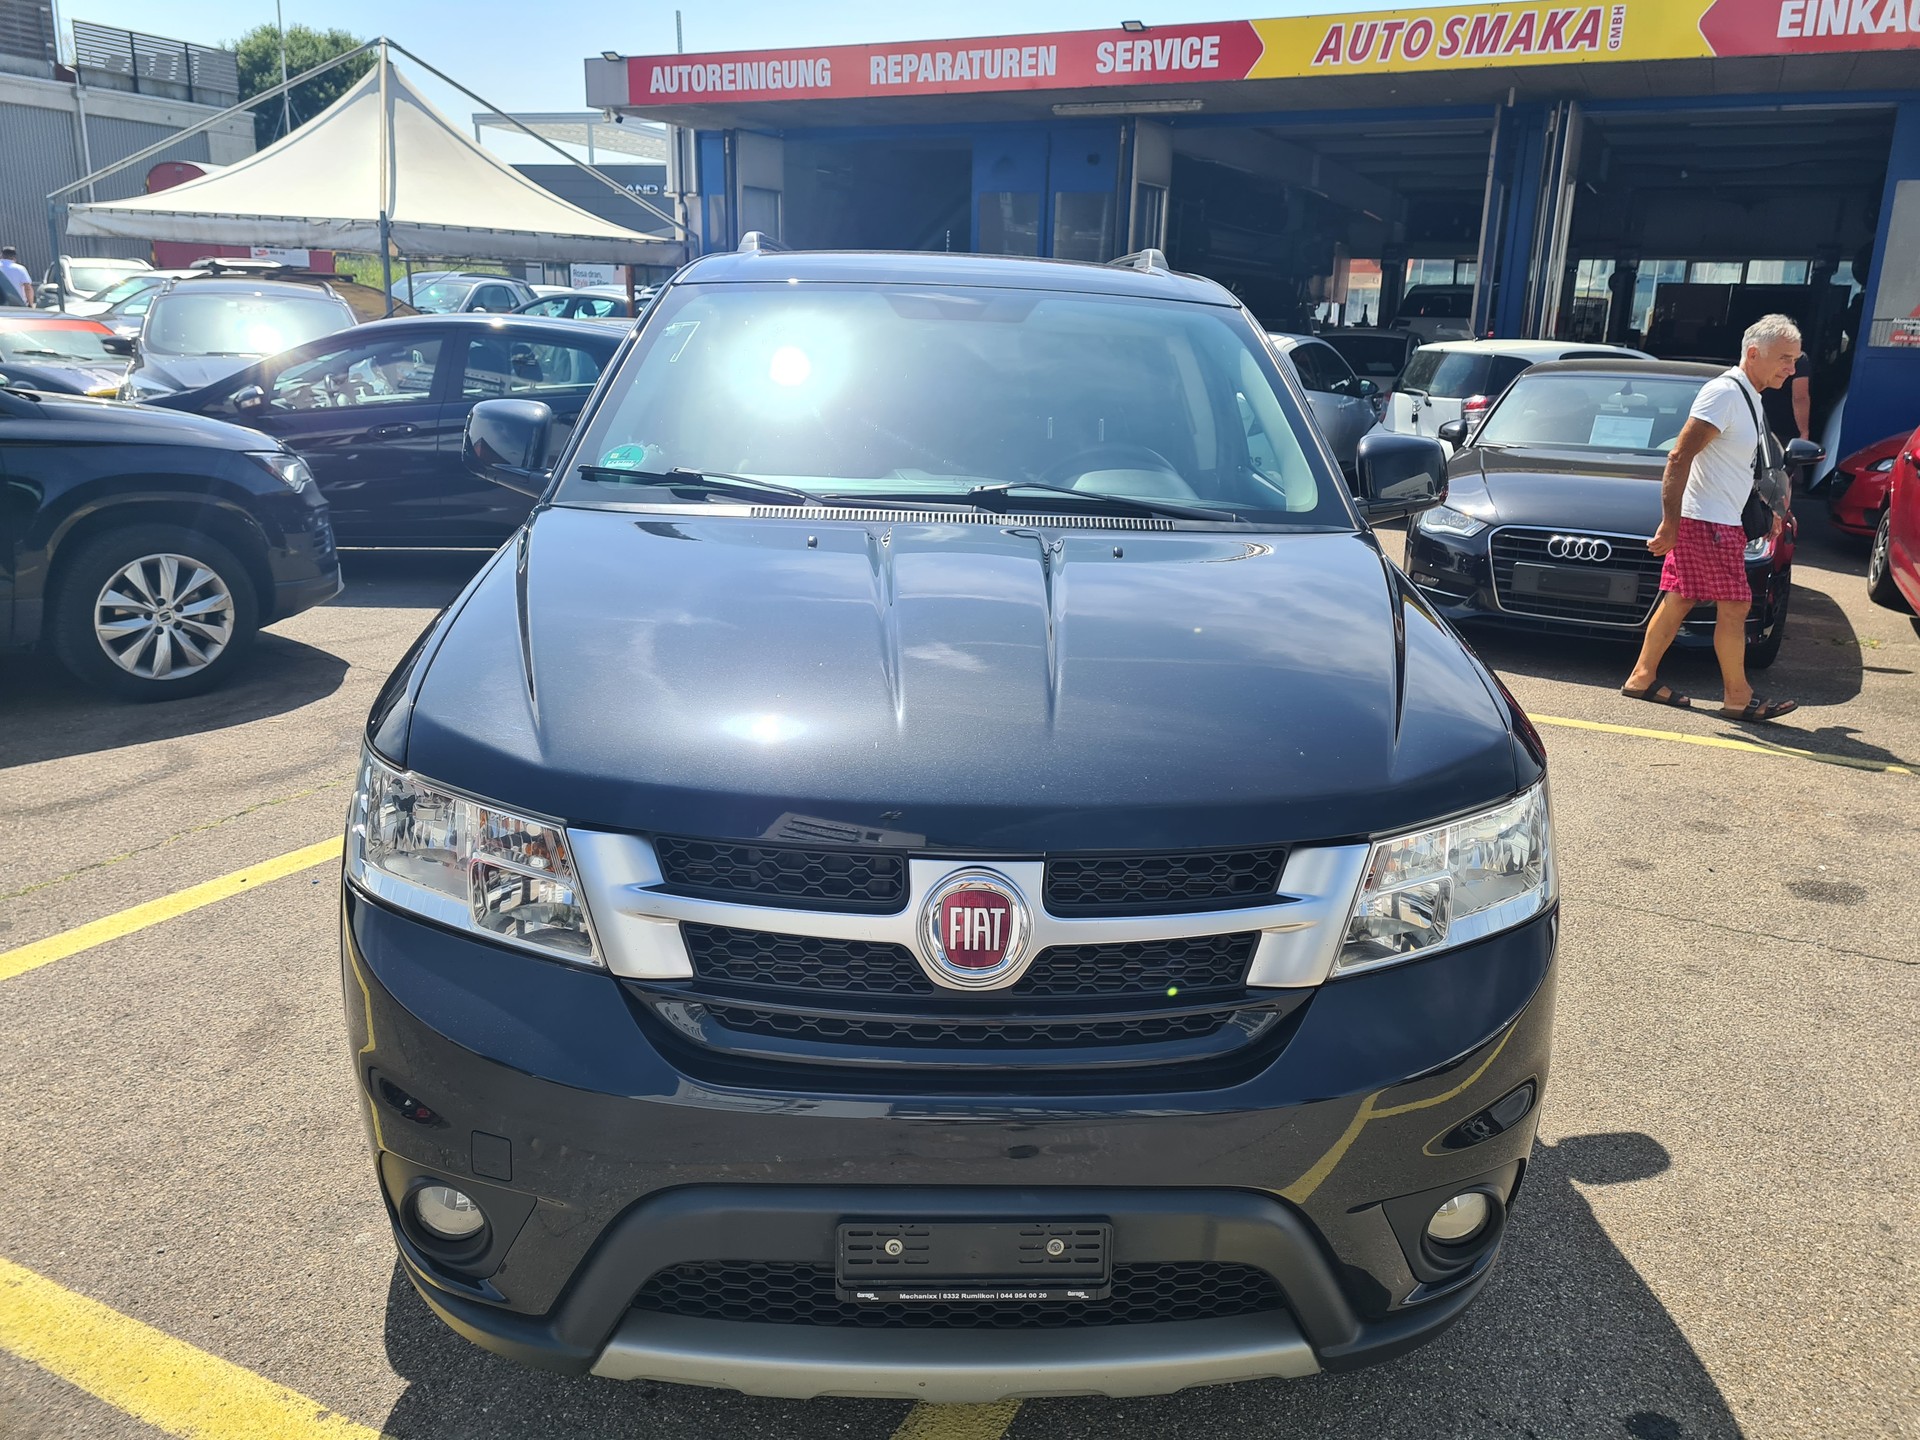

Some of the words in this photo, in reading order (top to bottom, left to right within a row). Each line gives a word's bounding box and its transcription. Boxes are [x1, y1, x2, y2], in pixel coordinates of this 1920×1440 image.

[1311, 17, 1435, 65] AUTO
[1437, 7, 1603, 58] SMAKA
[1608, 5, 1626, 51] GMBH
[870, 45, 1057, 85] REPARATUREN
[1096, 35, 1220, 74] SERVICE
[650, 58, 832, 94] AUTOREINIGUNG
[614, 184, 659, 195] AND
[949, 906, 1006, 951] FIAT
